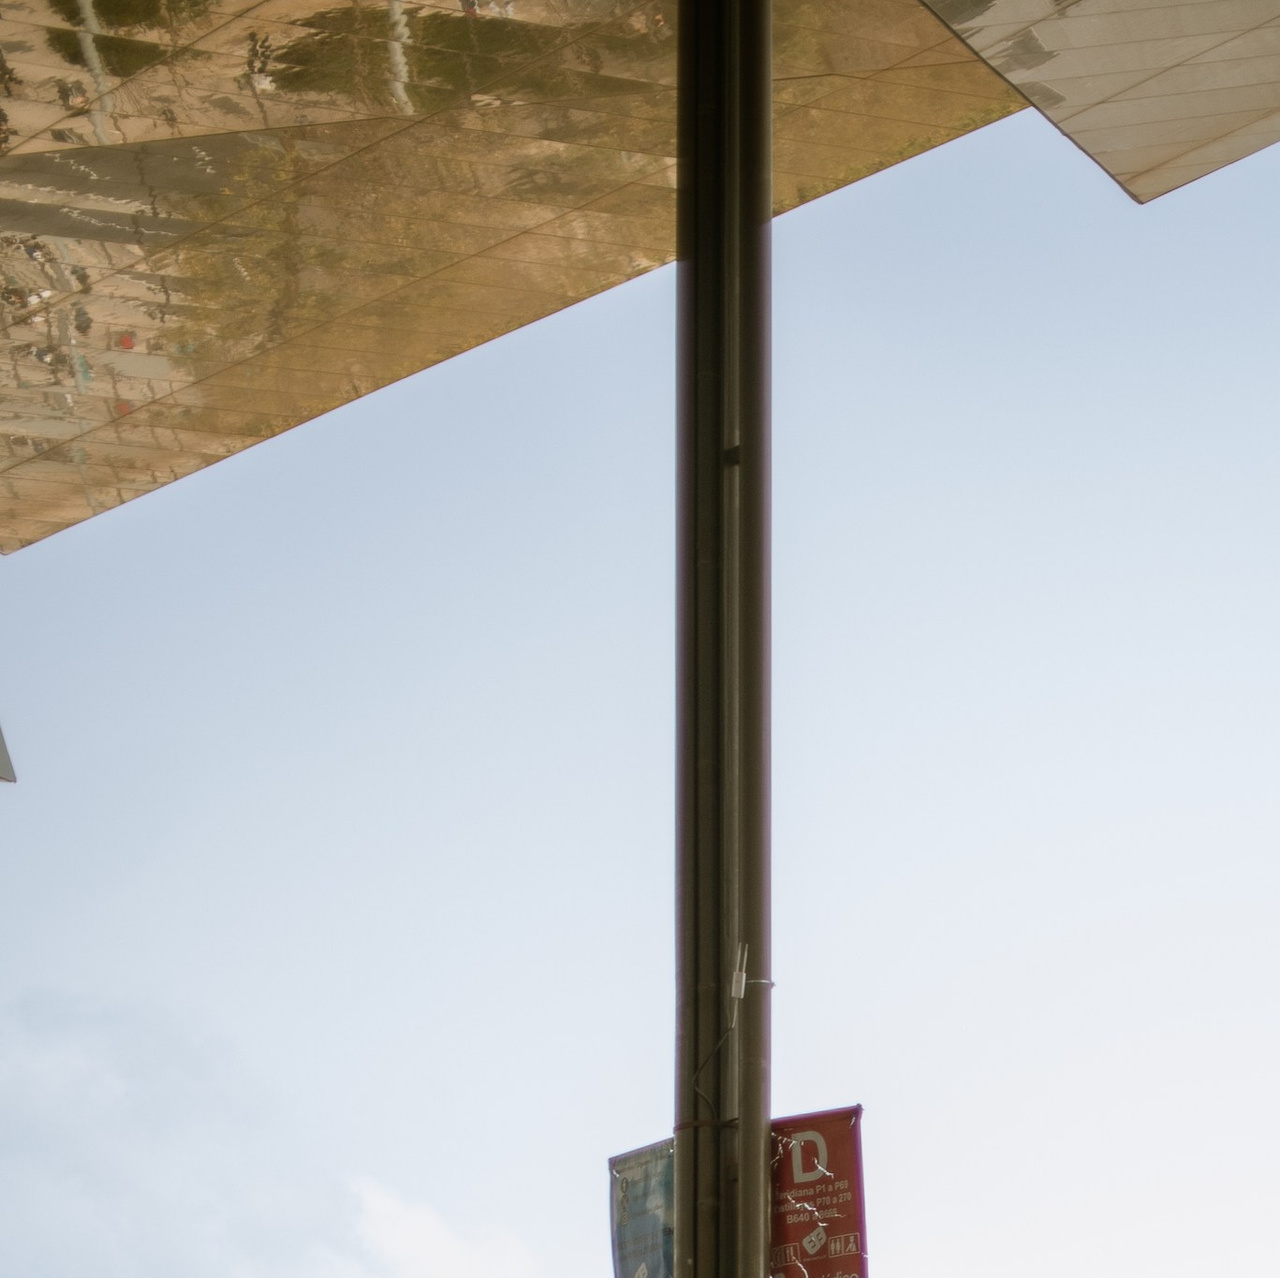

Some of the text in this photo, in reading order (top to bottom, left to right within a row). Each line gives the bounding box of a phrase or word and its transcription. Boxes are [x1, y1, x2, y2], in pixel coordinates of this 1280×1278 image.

[791, 1130, 829, 1183] D
[815, 1183, 826, 1194] P1
[827, 1184, 833, 1192] a
